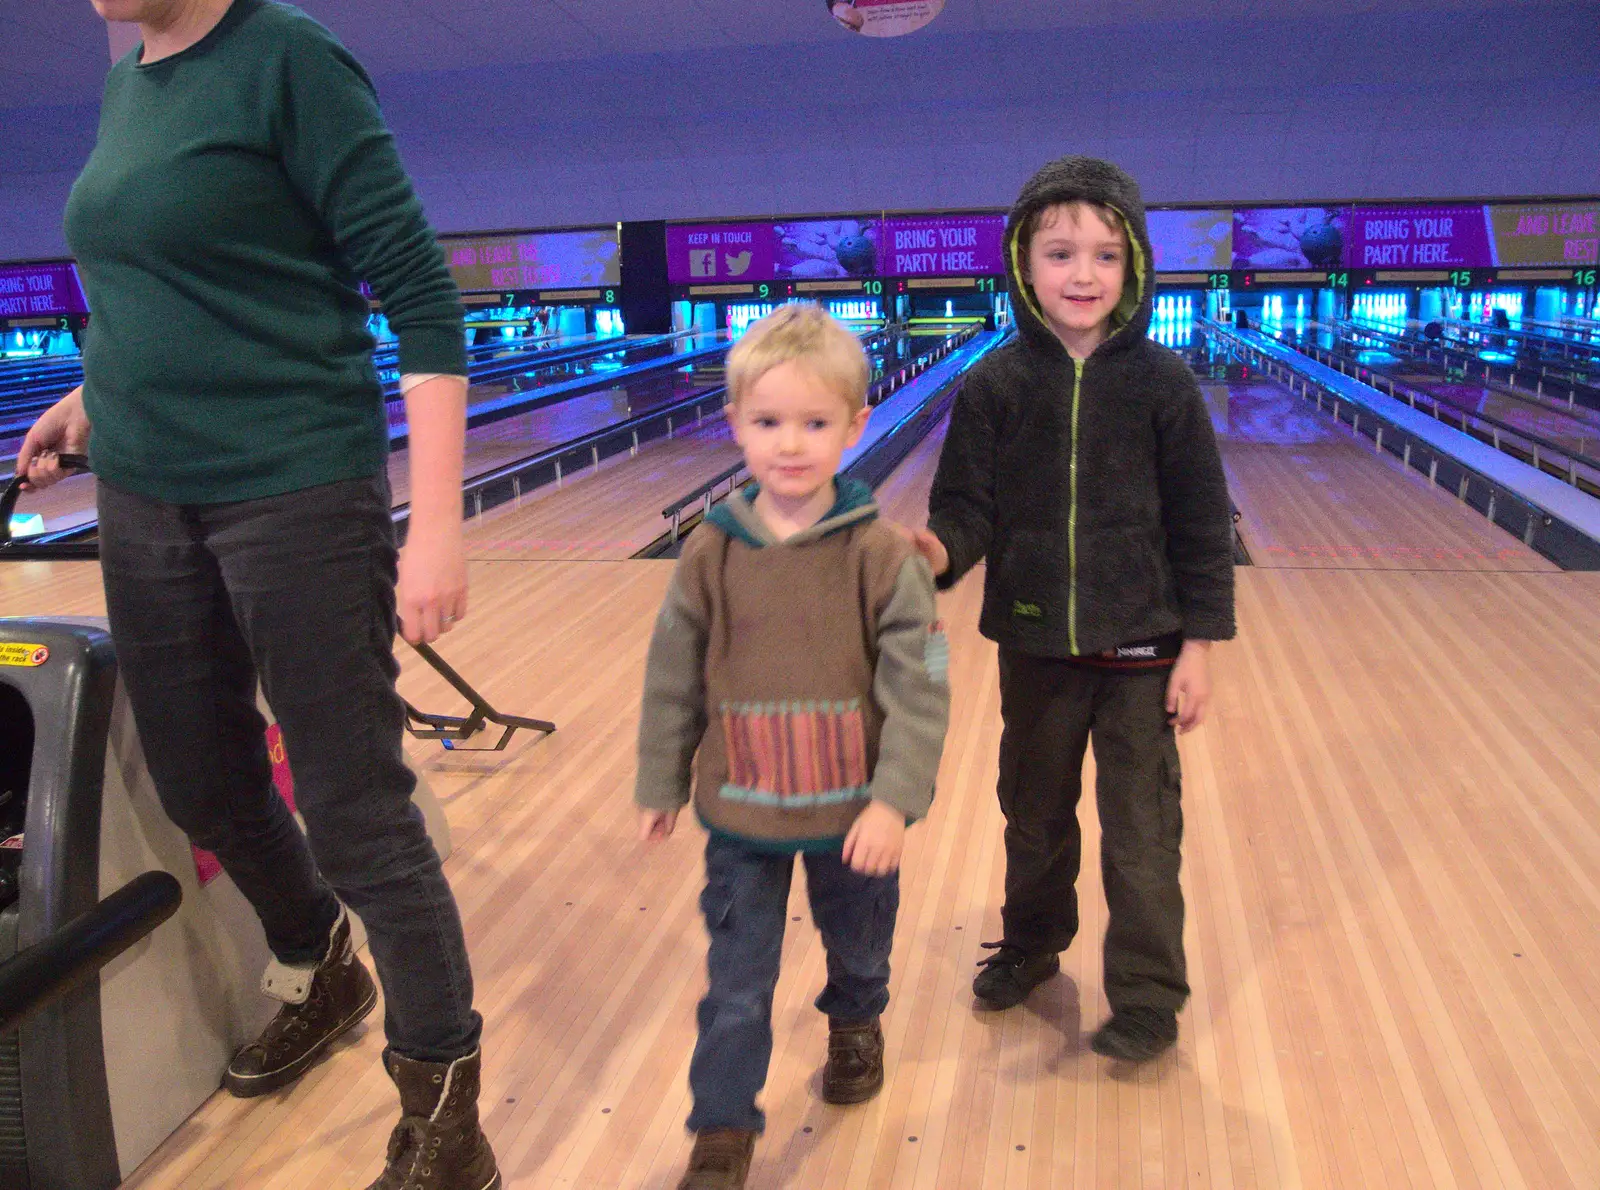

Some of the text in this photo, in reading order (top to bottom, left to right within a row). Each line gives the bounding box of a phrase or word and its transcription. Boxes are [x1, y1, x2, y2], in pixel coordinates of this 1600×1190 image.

[1364, 217, 1453, 240] BRING YOUR
[688, 231, 752, 244] KEEP IN TOUCH
[895, 227, 977, 250] BRING YOUR
[1364, 243, 1464, 265] PARTY HERE...
[895, 251, 989, 273] PARTY HERE...
[0, 275, 54, 293] RING YOUR
[1209, 274, 1229, 288] 13
[1328, 273, 1348, 287] 14
[1451, 271, 1471, 286] 15
[1574, 270, 1596, 285] 16
[759, 284, 769, 298] 9
[863, 280, 882, 295] 10
[977, 278, 994, 292] 11
[506, 294, 514, 306] 7
[605, 290, 614, 304] 8
[60, 318, 69, 330] 2
